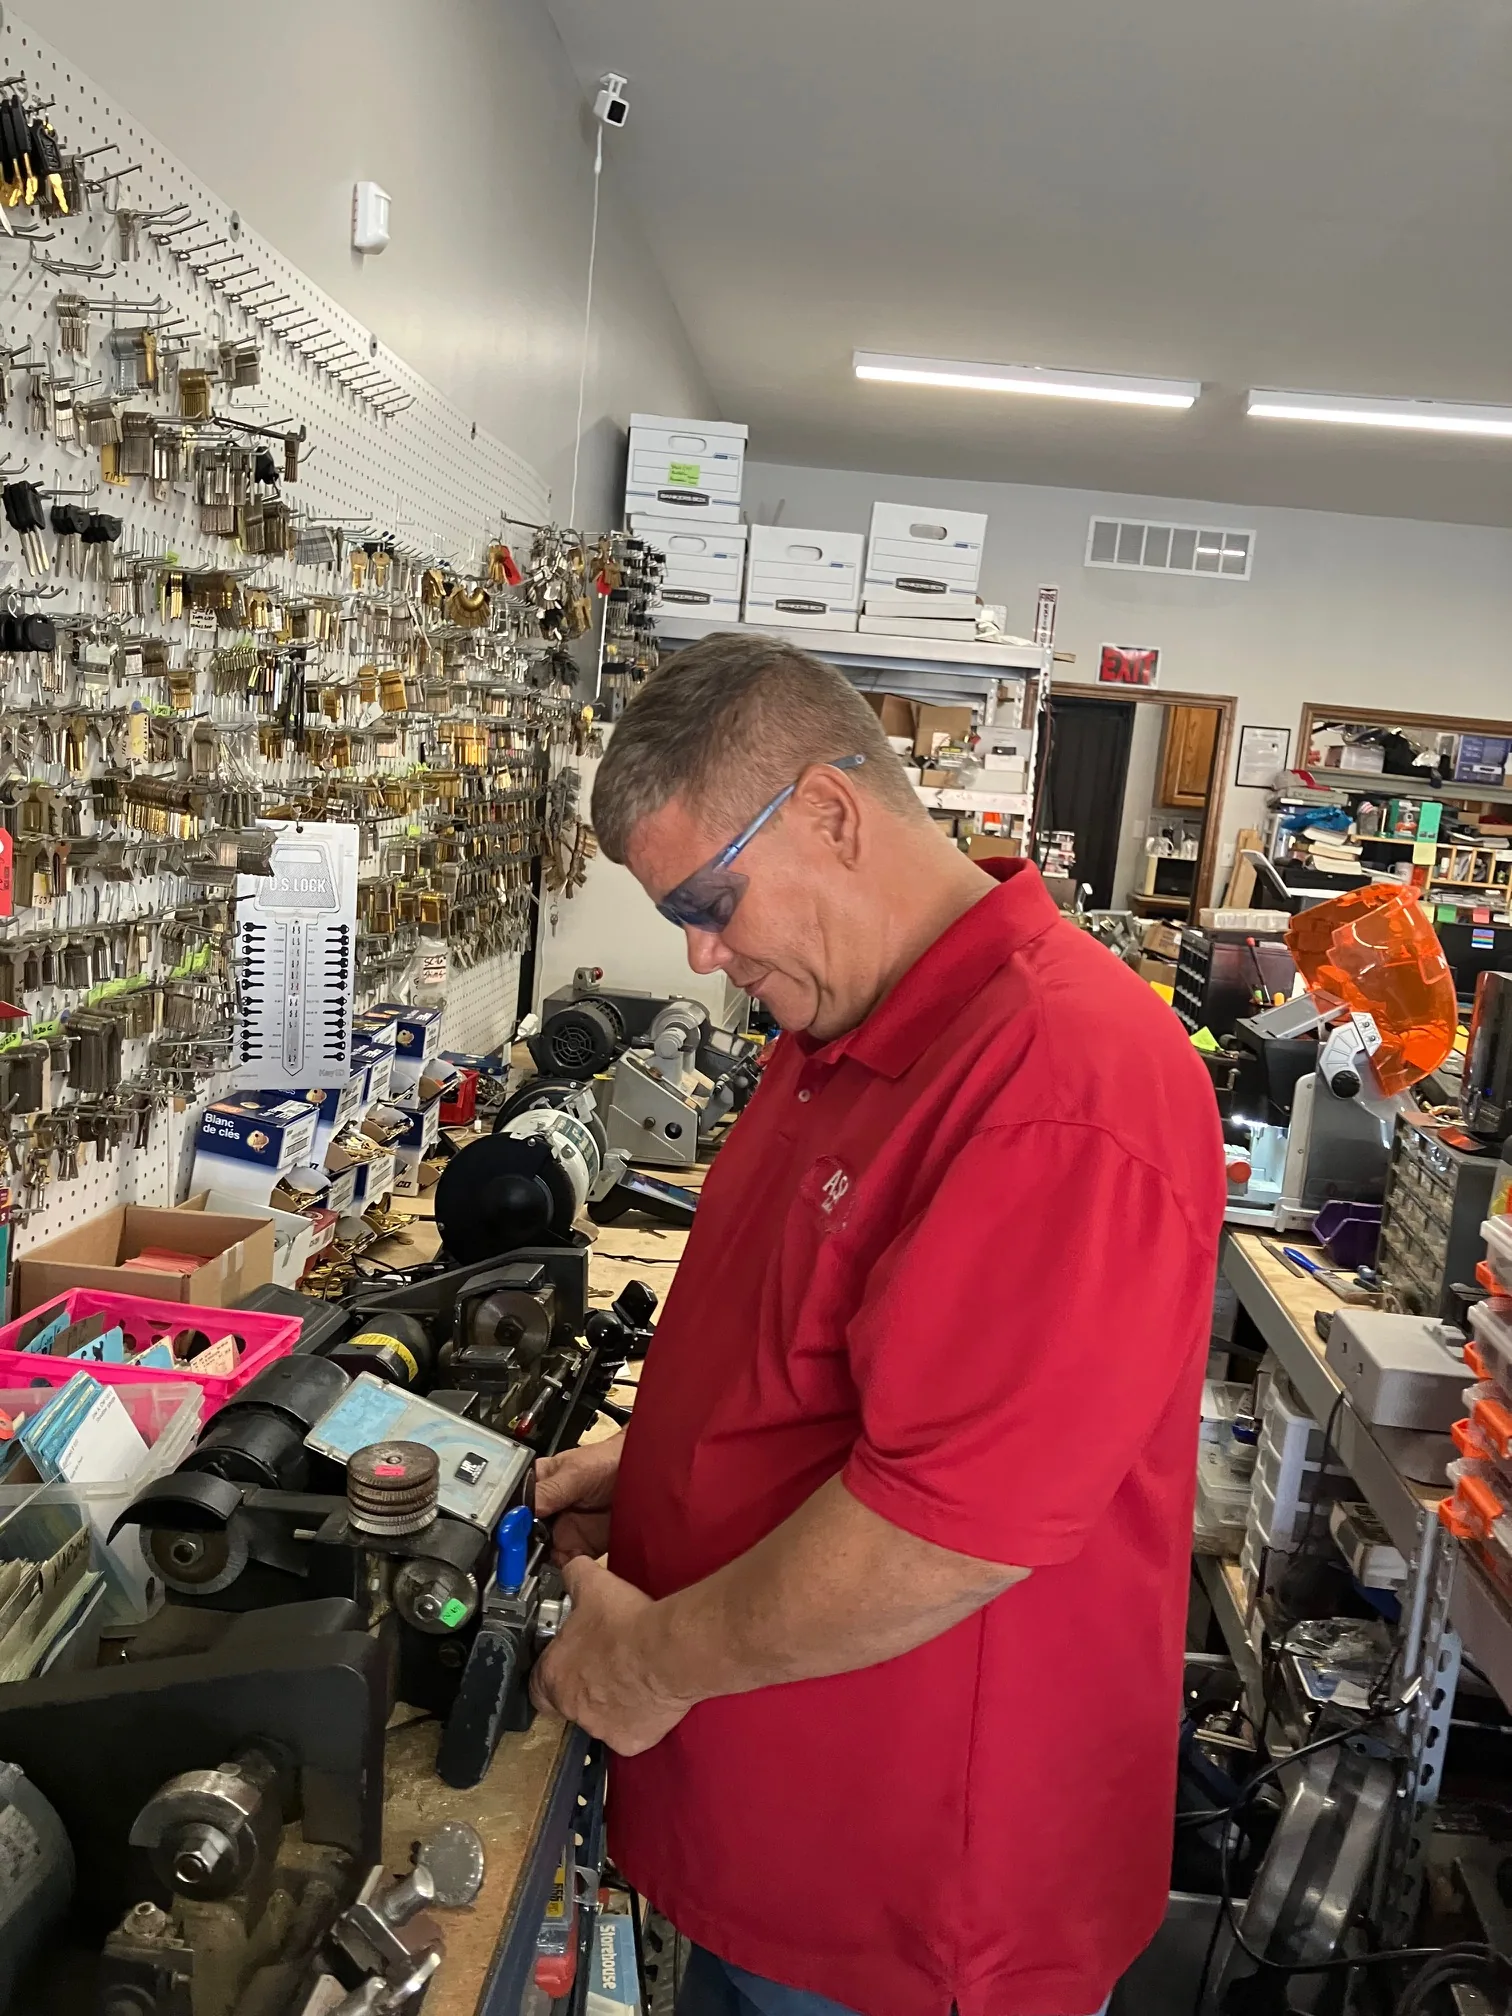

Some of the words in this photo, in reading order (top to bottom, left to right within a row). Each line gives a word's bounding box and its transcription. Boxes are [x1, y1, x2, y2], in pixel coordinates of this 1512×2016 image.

[1102, 648, 1156, 685] EXIT
[293, 878, 327, 893] LOCK
[205, 1113, 234, 1128] Blanc
[202, 1124, 216, 1135] de
[218, 1128, 240, 1140] clés
[600, 1924, 617, 1990] Storehouse
